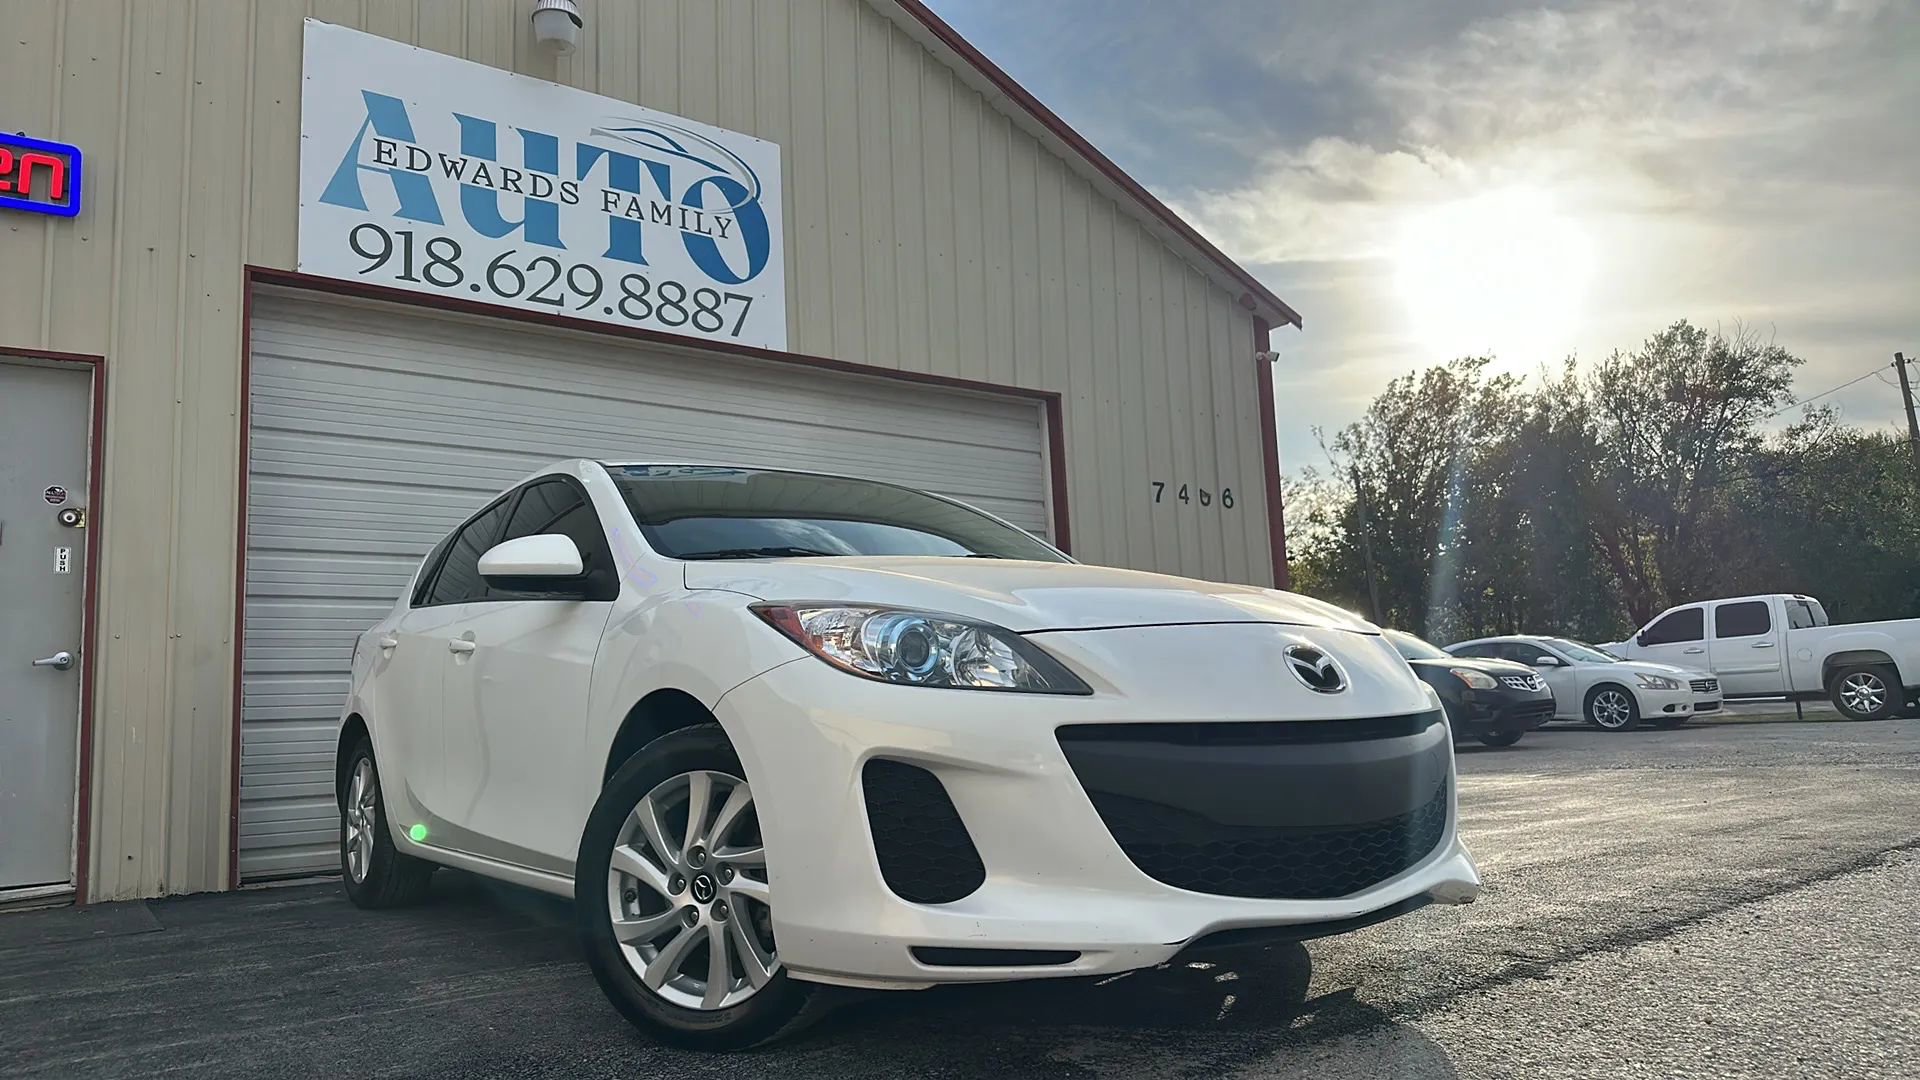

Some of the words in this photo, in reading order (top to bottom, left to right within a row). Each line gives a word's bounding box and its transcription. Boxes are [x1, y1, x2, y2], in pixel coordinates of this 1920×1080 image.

[319, 90, 771, 285] AUTO
[372, 137, 580, 206] EDWARDS
[600, 188, 732, 240] FAMILY
[348, 223, 753, 338] 918.629.8887
[59, 548, 67, 572] PUSH
